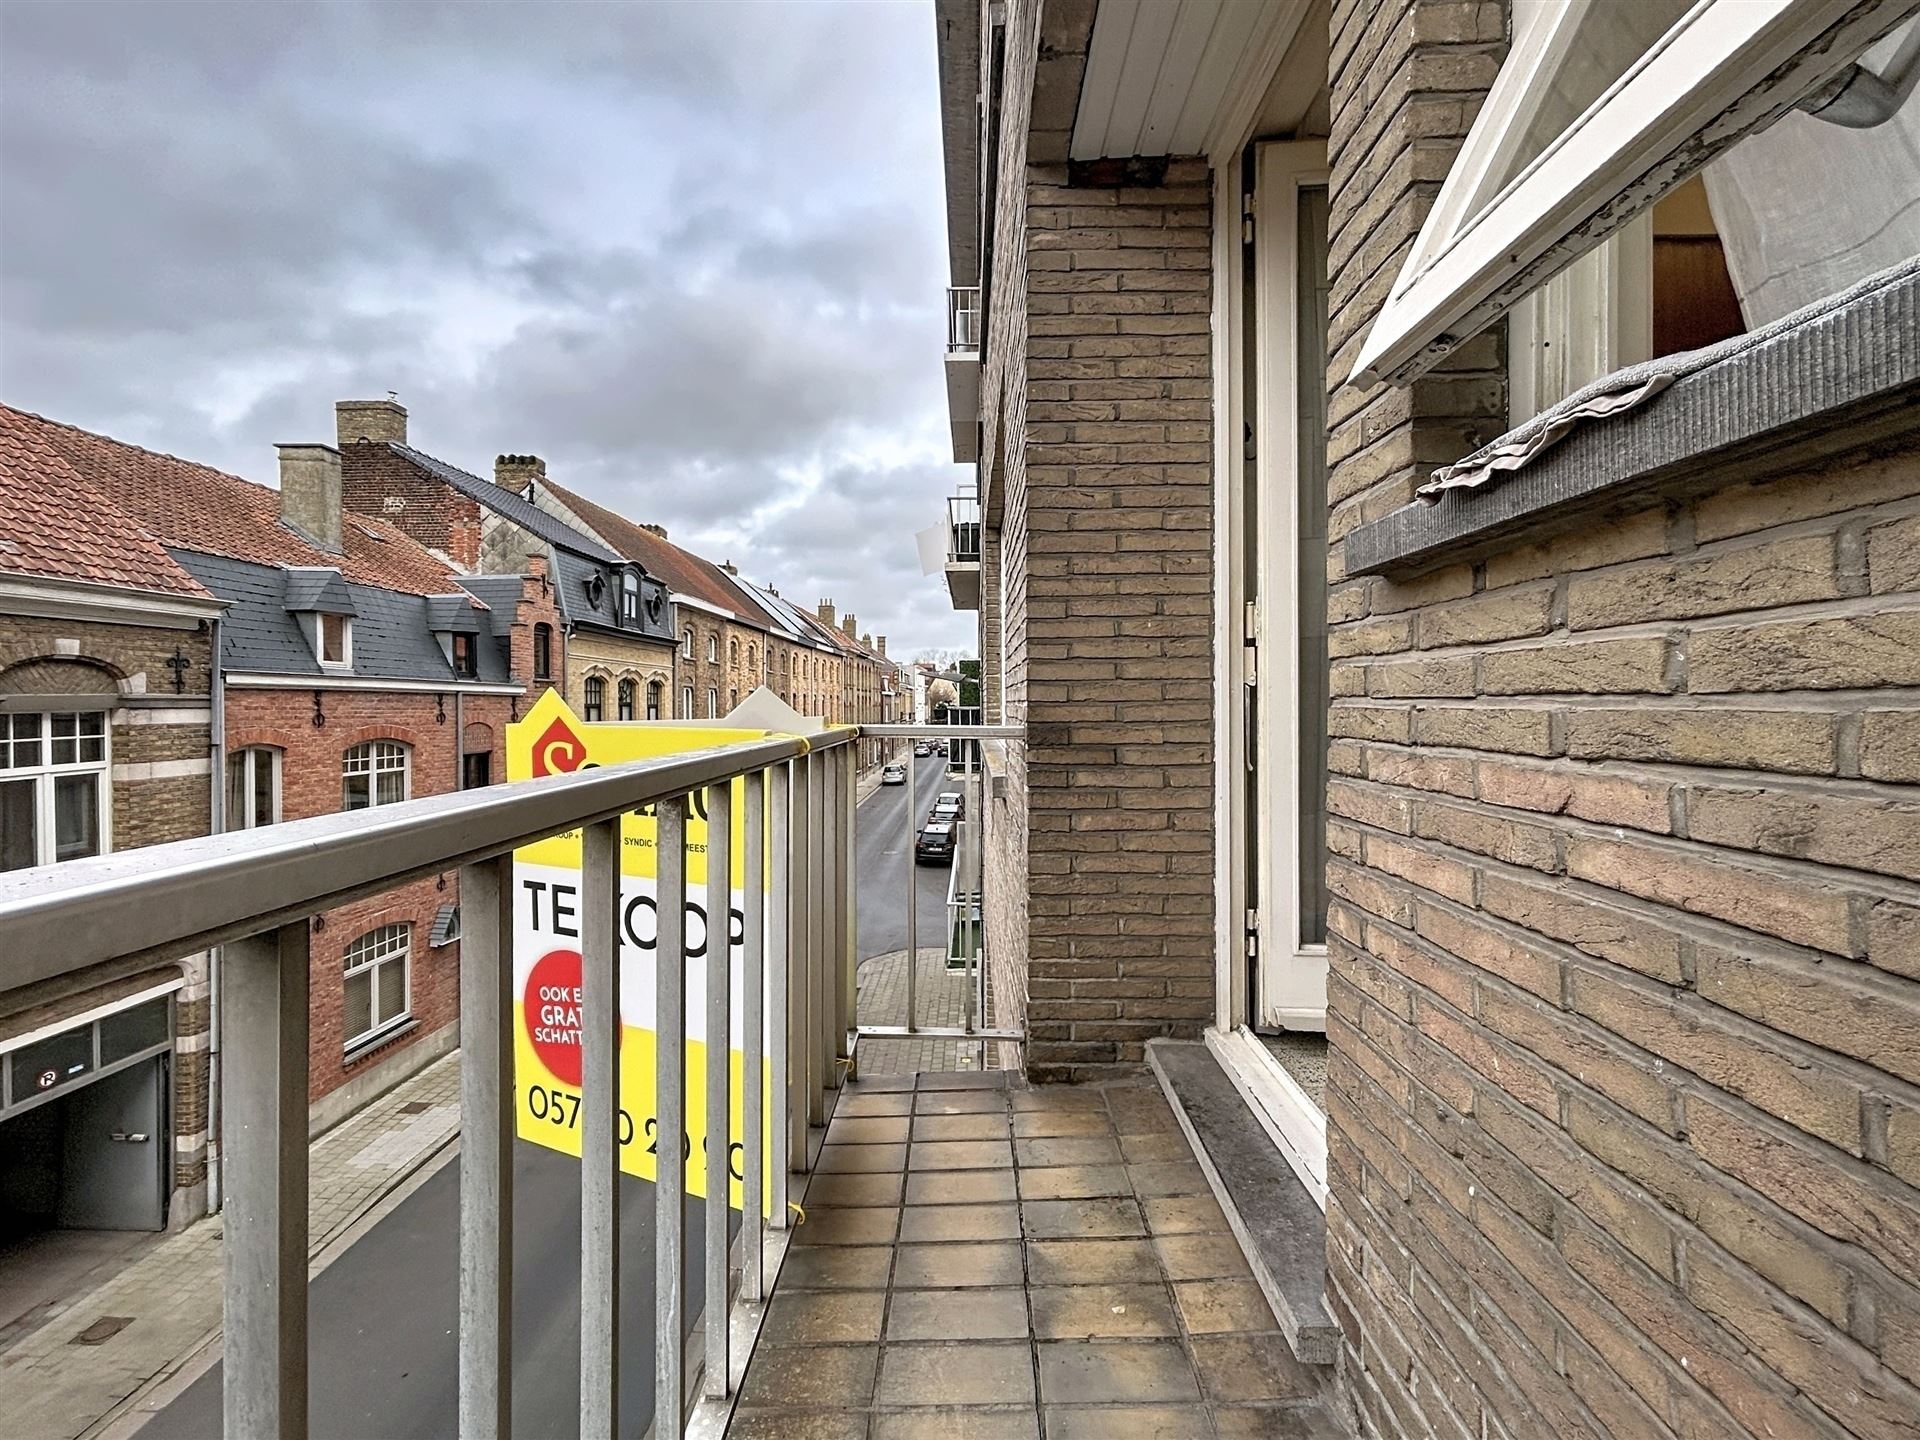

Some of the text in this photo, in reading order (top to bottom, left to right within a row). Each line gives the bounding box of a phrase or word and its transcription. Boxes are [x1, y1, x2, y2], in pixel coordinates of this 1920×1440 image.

[624, 837, 652, 848] SYNDIC
[523, 880, 744, 958] TE OOP
[540, 986, 570, 1002] OOK
[541, 1005, 582, 1027] GRAT
[535, 1027, 582, 1045] SCHATT
